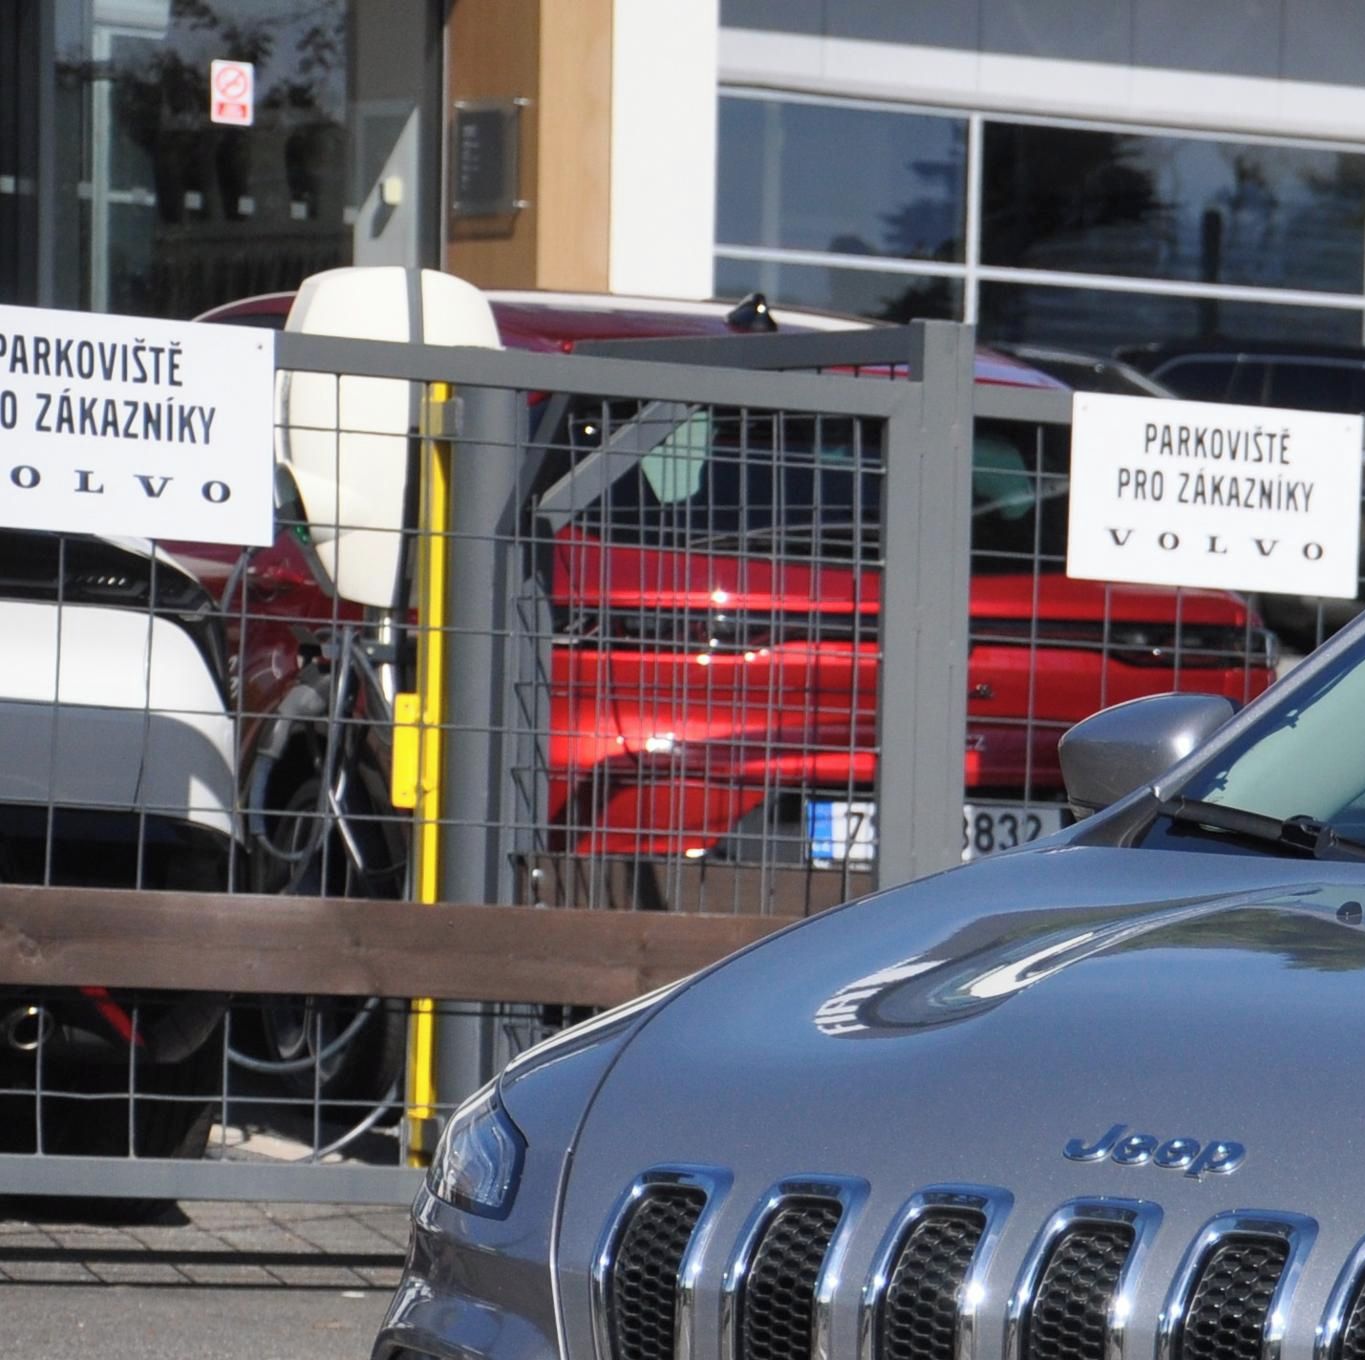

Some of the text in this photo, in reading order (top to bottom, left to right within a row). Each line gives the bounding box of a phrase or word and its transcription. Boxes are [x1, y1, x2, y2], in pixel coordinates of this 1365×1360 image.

[35, 388, 216, 445] ZÁKAZNÍKY
[1144, 423, 1291, 464] PARKOVIŠTĚ
[1117, 467, 1314, 512] PRO ZÁKAZNÍKY
[1108, 527, 1324, 561] VOLVO
[964, 813, 1042, 851] 832
[1063, 1124, 1247, 1178] Jeep
